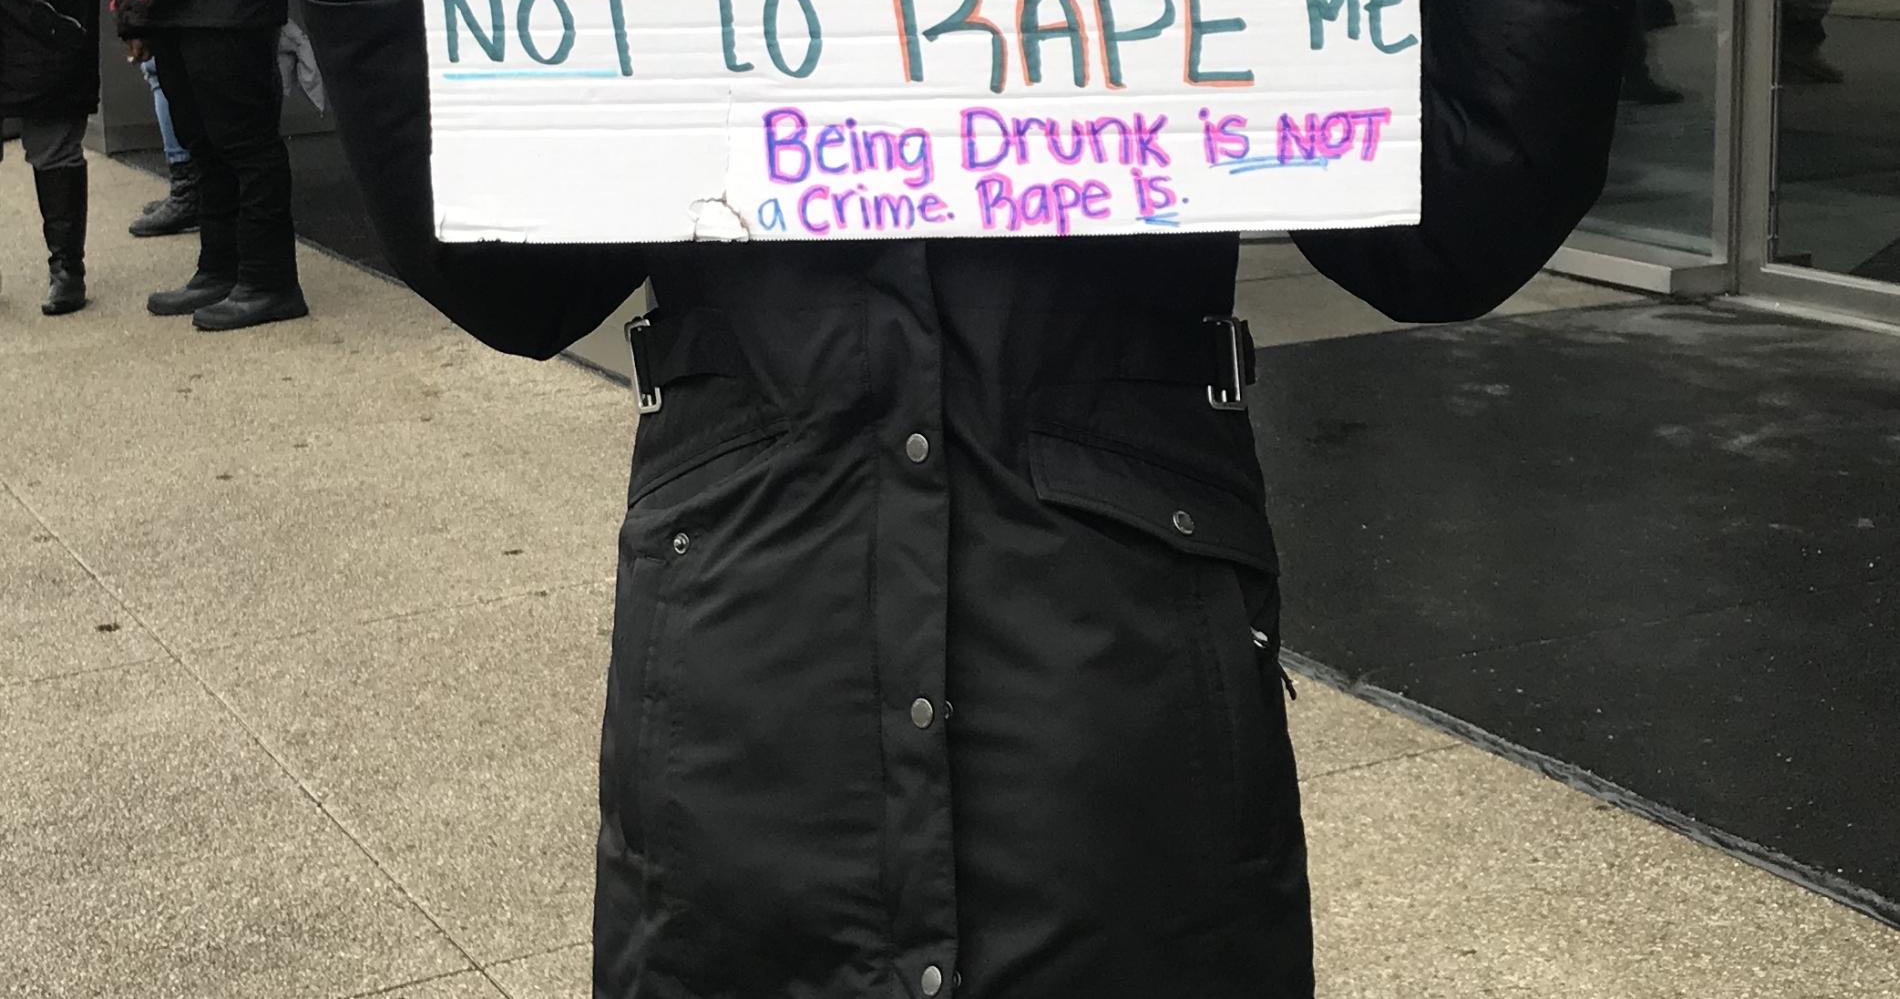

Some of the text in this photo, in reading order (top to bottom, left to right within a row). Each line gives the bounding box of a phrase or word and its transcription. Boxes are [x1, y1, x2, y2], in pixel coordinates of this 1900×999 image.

[763, 106, 1392, 188] Being Drunk is NOT
[758, 197, 787, 232] a
[976, 173, 1112, 236] Rape
